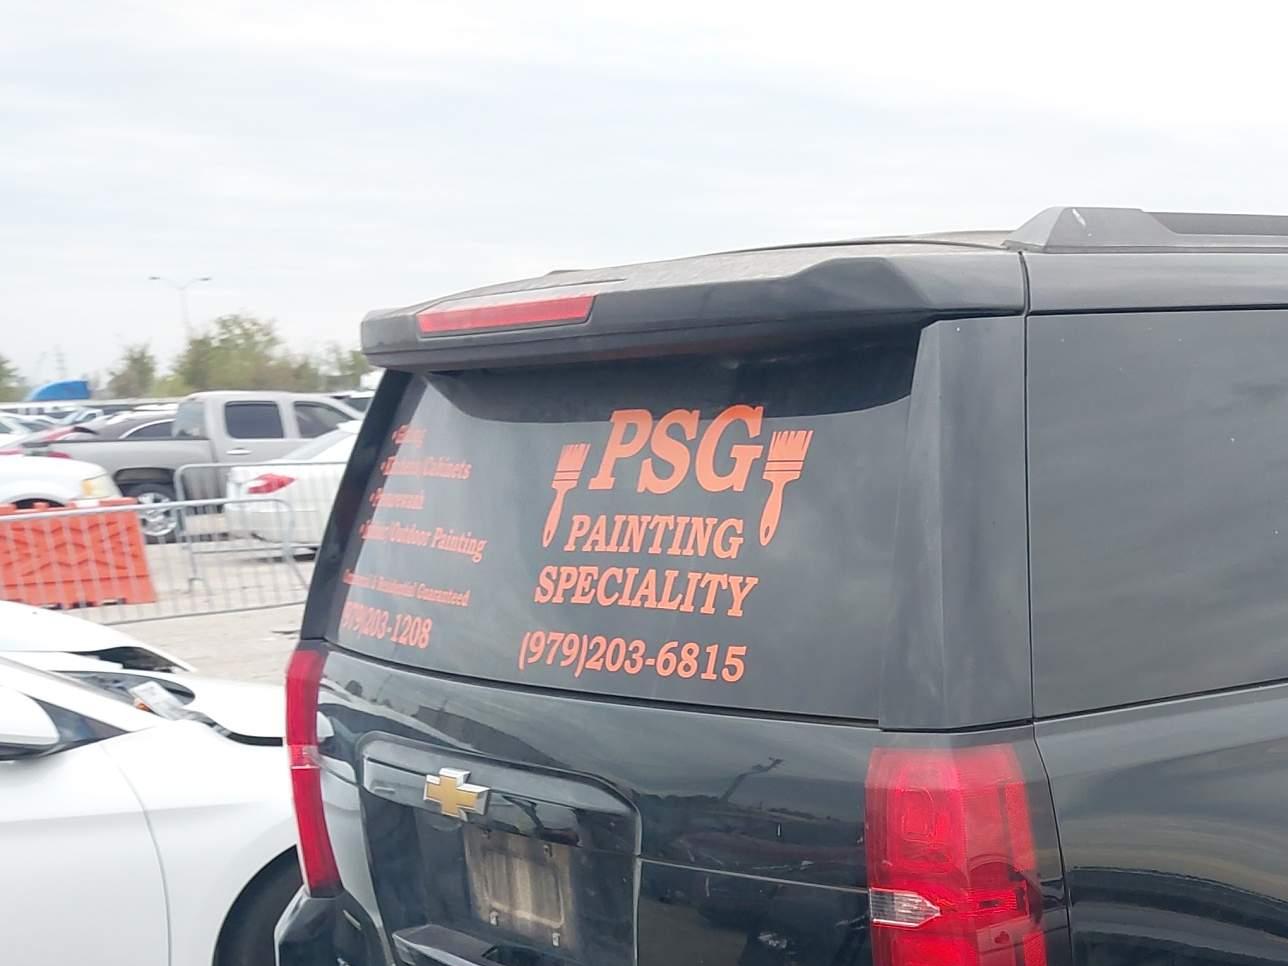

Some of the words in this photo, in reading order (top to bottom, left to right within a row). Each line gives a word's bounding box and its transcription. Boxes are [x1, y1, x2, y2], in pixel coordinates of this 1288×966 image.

[588, 404, 764, 494] PSG
[432, 527, 488, 563] Painting
[564, 514, 744, 559] PAINTING
[534, 566, 758, 617] SPECIALITY
[518, 631, 747, 682] (979)203-6815
